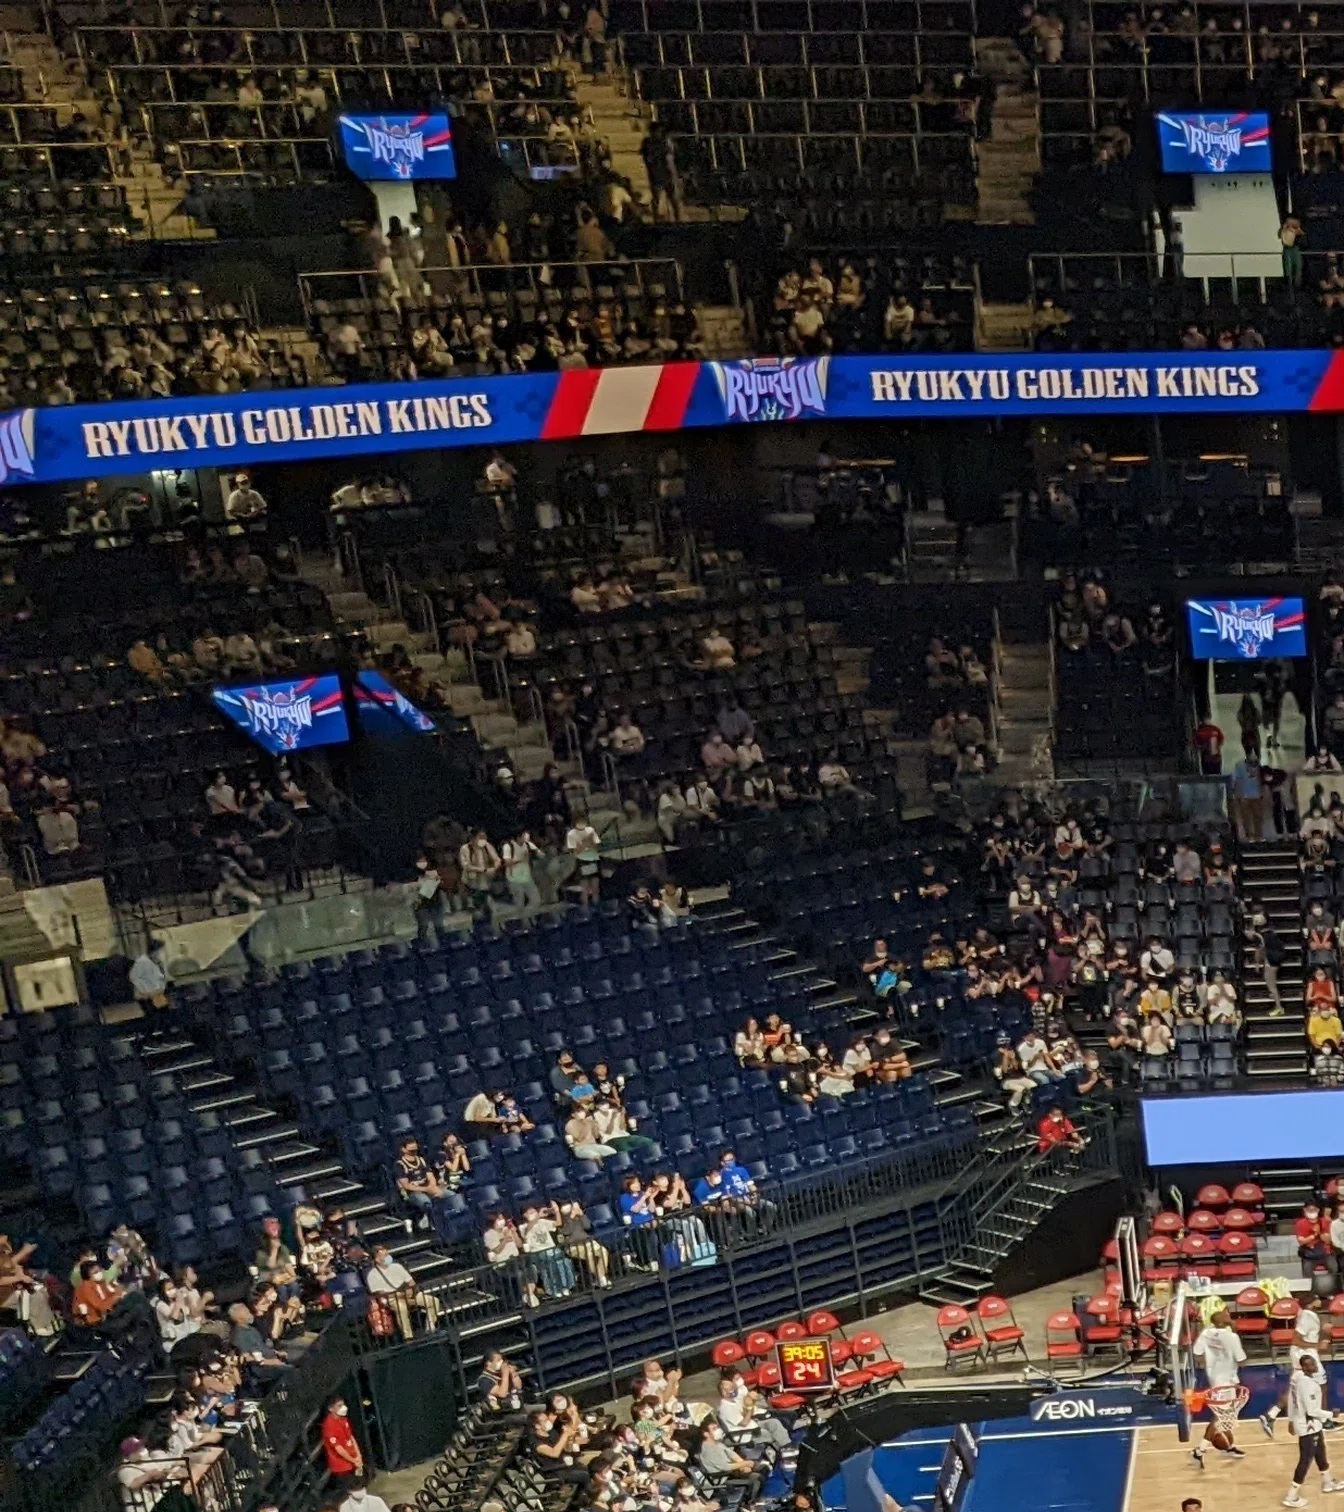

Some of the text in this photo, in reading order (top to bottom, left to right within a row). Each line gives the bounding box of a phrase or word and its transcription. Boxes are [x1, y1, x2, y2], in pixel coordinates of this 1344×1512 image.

[869, 366, 1260, 402] RYUKYU GOLDEN KINGS
[82, 412, 237, 458] RYUKYU
[241, 401, 383, 445] GOLDEN
[387, 394, 494, 434] KINGS
[783, 1345, 825, 1361] 39:05
[793, 1362, 821, 1381] 24
